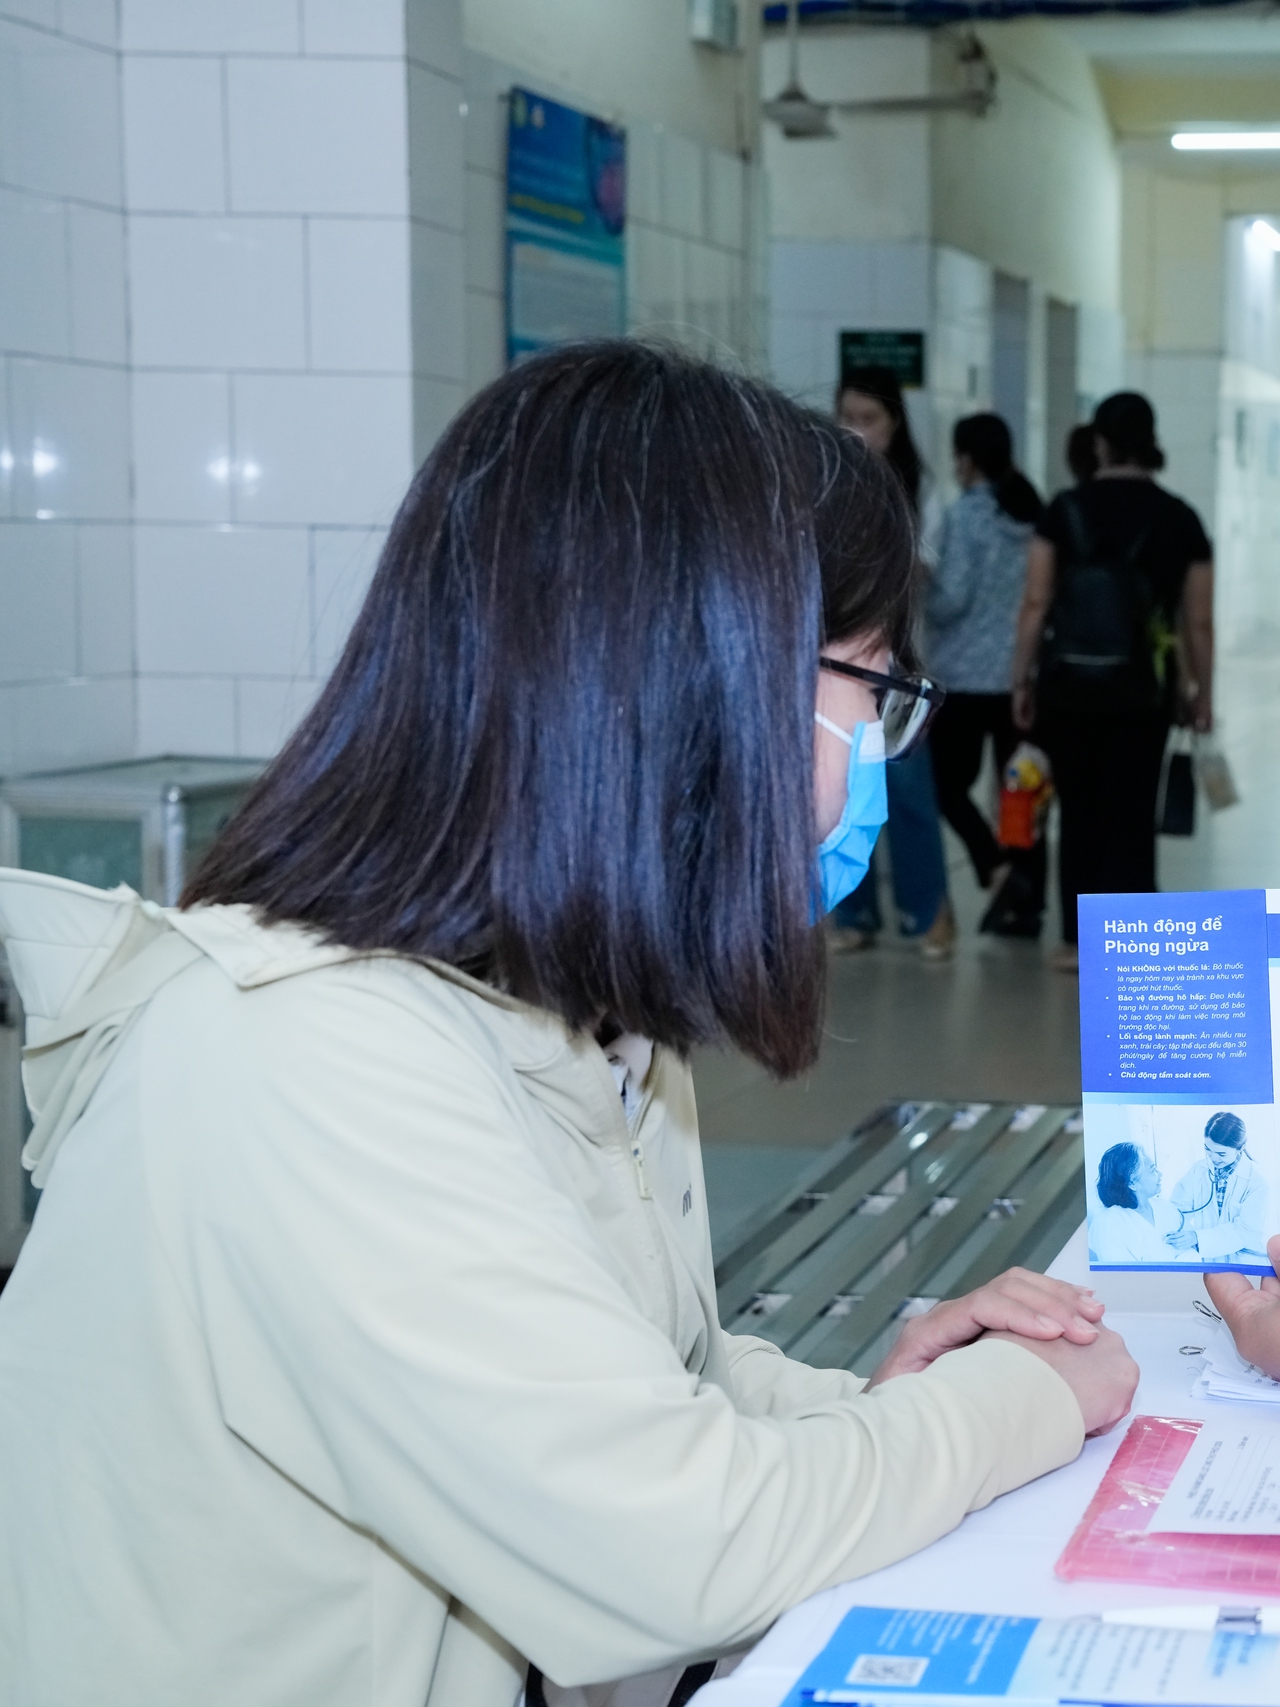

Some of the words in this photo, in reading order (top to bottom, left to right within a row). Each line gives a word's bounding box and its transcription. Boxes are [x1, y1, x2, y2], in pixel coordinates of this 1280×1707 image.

[1105, 920, 1148, 933] Hành
[1154, 919, 1197, 935] động
[1202, 915, 1223, 931] để
[1105, 940, 1160, 956] Phòng
[1165, 938, 1209, 955] ngừa
[1132, 964, 1161, 972] KHÔNG
[1177, 963, 1199, 971] thuốc
[1224, 962, 1244, 970] thuốc
[1128, 985, 1148, 993] người
[1148, 994, 1173, 1002] đường
[1200, 1003, 1218, 1011] dụng
[1158, 1023, 1171, 1031] hại.
[1119, 1032, 1131, 1040] Lối
[1134, 1032, 1152, 1041] sống
[1193, 1042, 1207, 1050] dục
[1171, 1053, 1187, 1061] tăng
[1138, 1072, 1157, 1080] động
